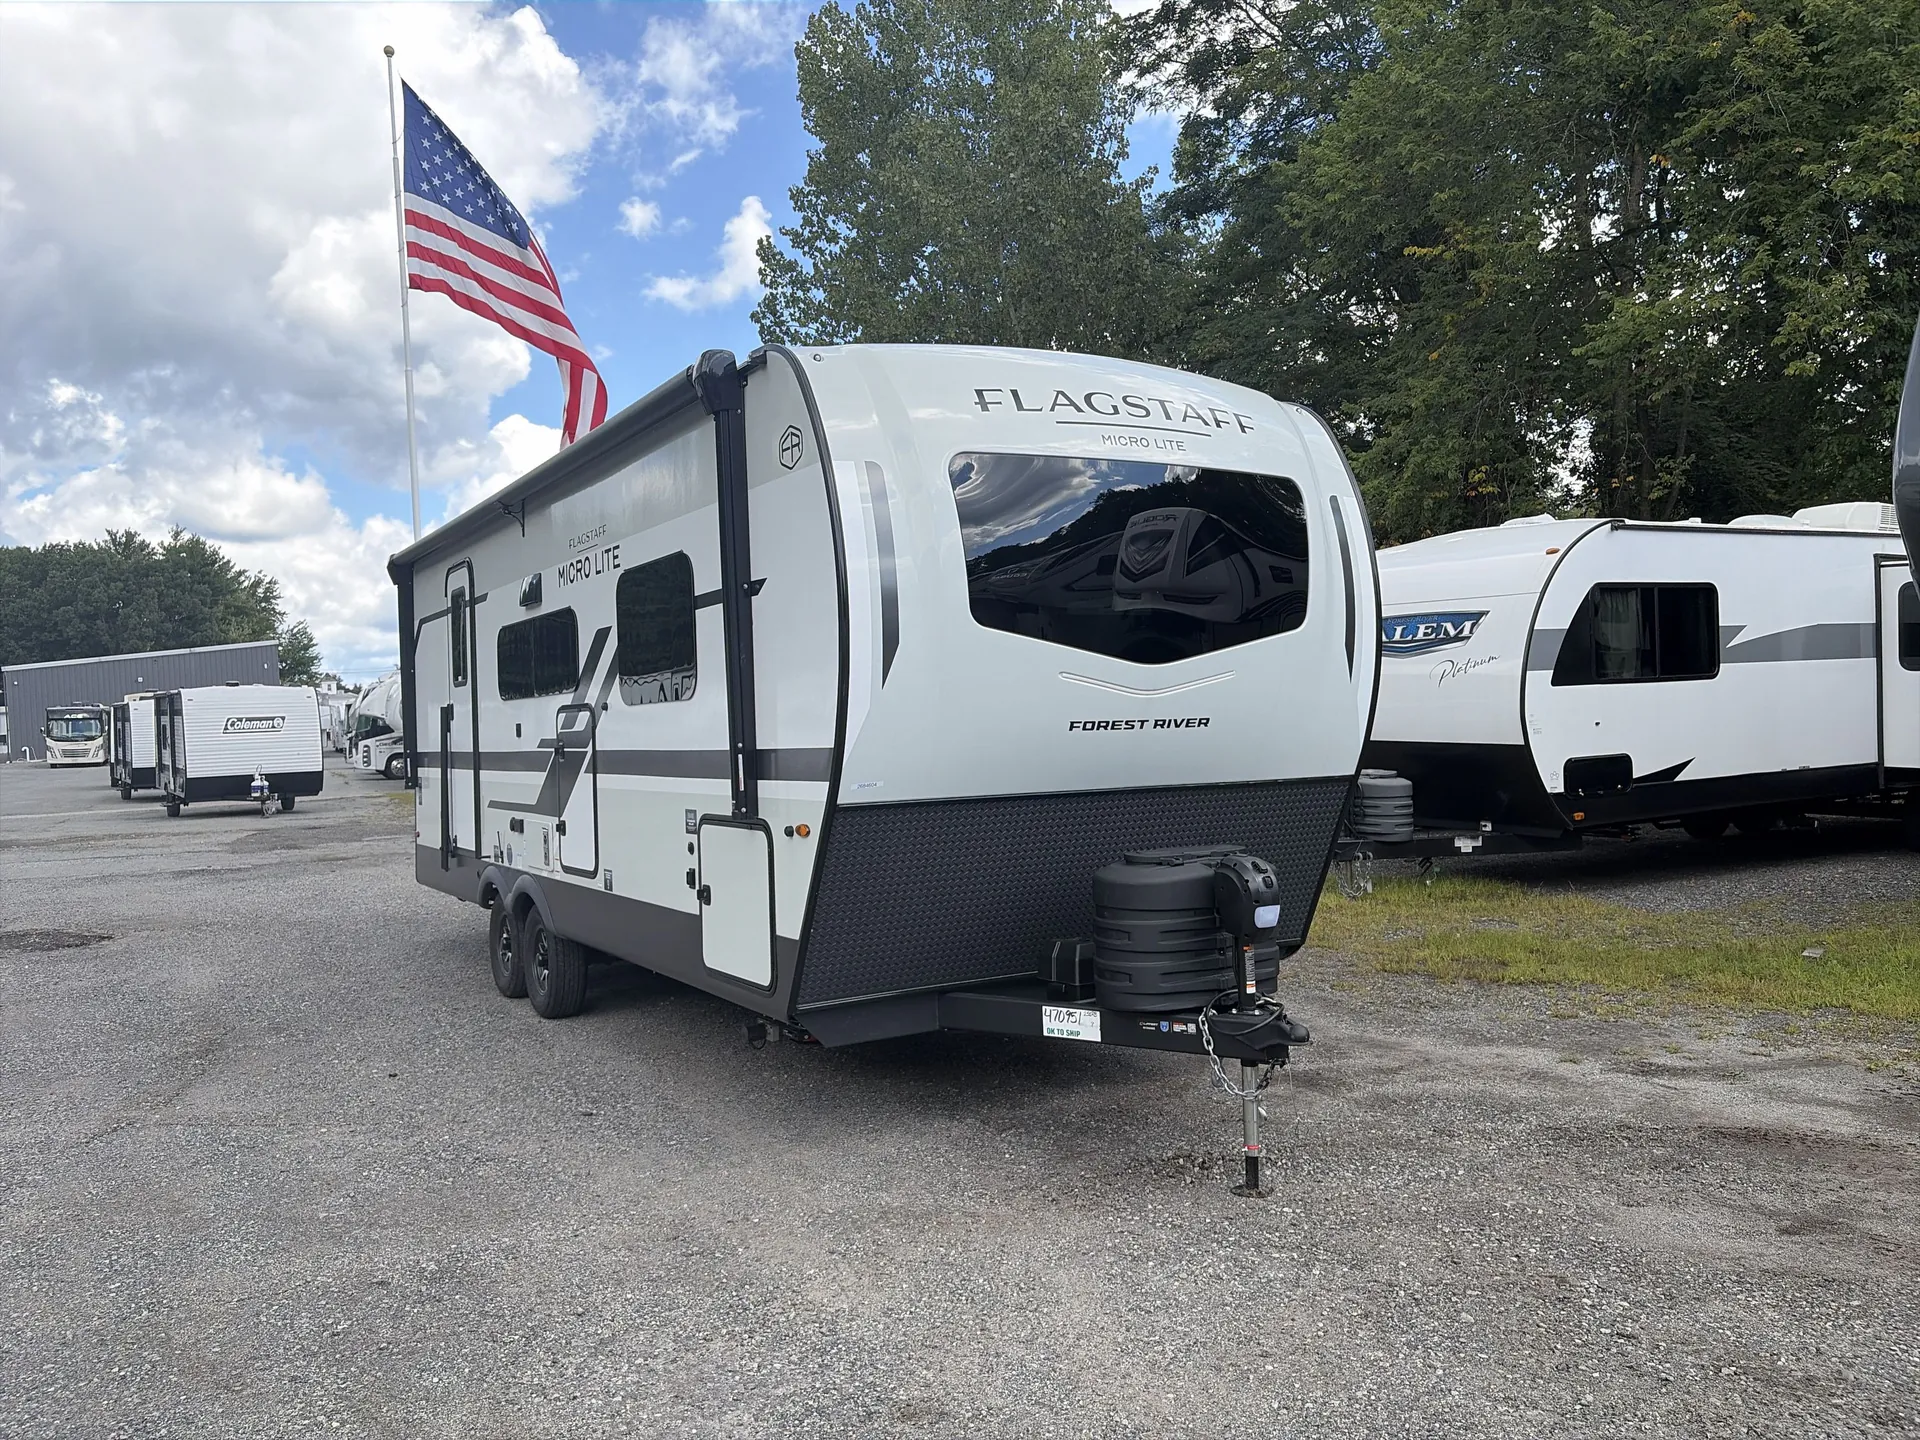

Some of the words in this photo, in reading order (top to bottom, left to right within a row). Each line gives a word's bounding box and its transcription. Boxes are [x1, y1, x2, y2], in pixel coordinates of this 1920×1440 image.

[973, 388, 1255, 434] FLAGSTAFF
[1101, 434, 1150, 448] MICRO
[1154, 438, 1187, 451] LITE
[568, 524, 607, 549] FLAGSTAFF
[558, 555, 591, 588] MICRO
[594, 544, 621, 575] LITE
[1382, 620, 1477, 641] LEM
[1429, 655, 1501, 688] Platinum
[227, 718, 273, 731] Coleman
[1068, 719, 1149, 731] FOREST
[1153, 717, 1210, 729] RIVER
[1044, 1008, 1082, 1025] 470951
[1046, 1027, 1056, 1035] OK
[1066, 1029, 1081, 1037] SHIP
